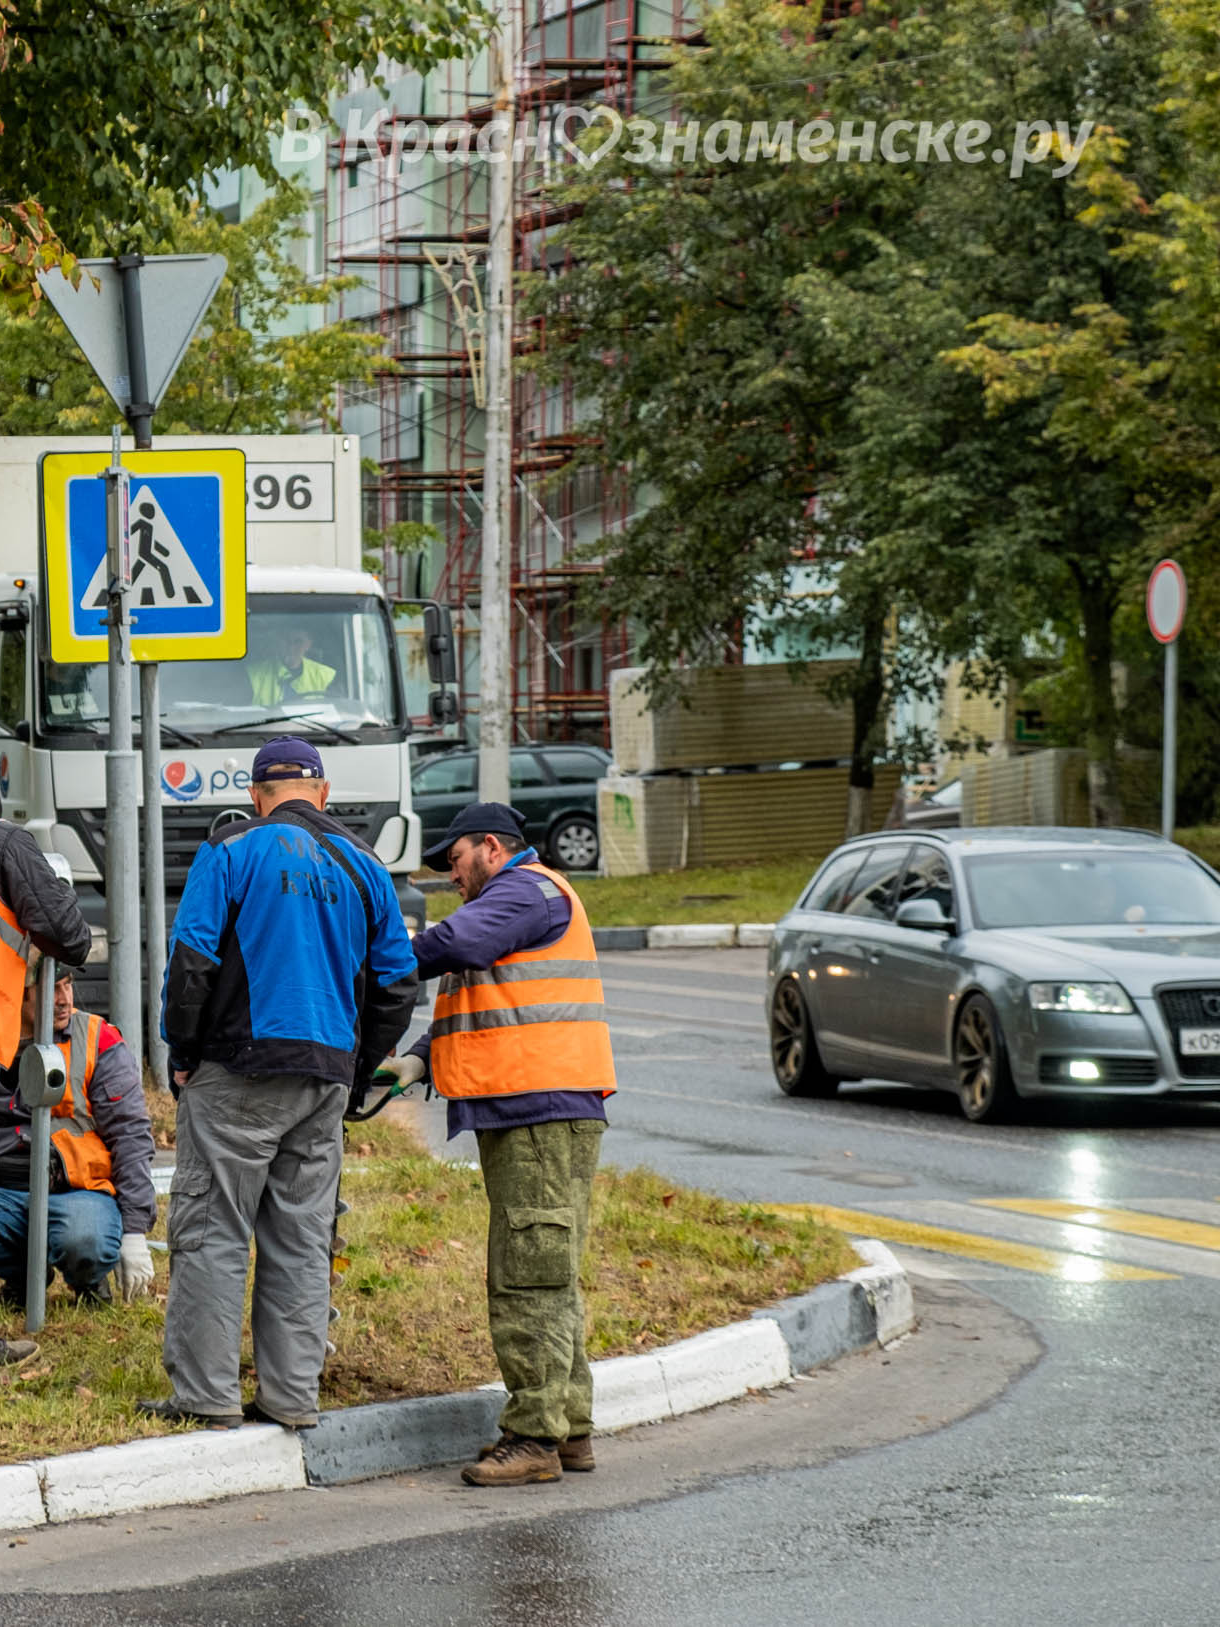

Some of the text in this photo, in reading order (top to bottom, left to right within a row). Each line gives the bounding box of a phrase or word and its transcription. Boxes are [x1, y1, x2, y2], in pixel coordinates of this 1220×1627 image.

[245, 473, 312, 510] 96
[210, 769, 254, 795] pe
[1186, 1033, 1220, 1051] К09
